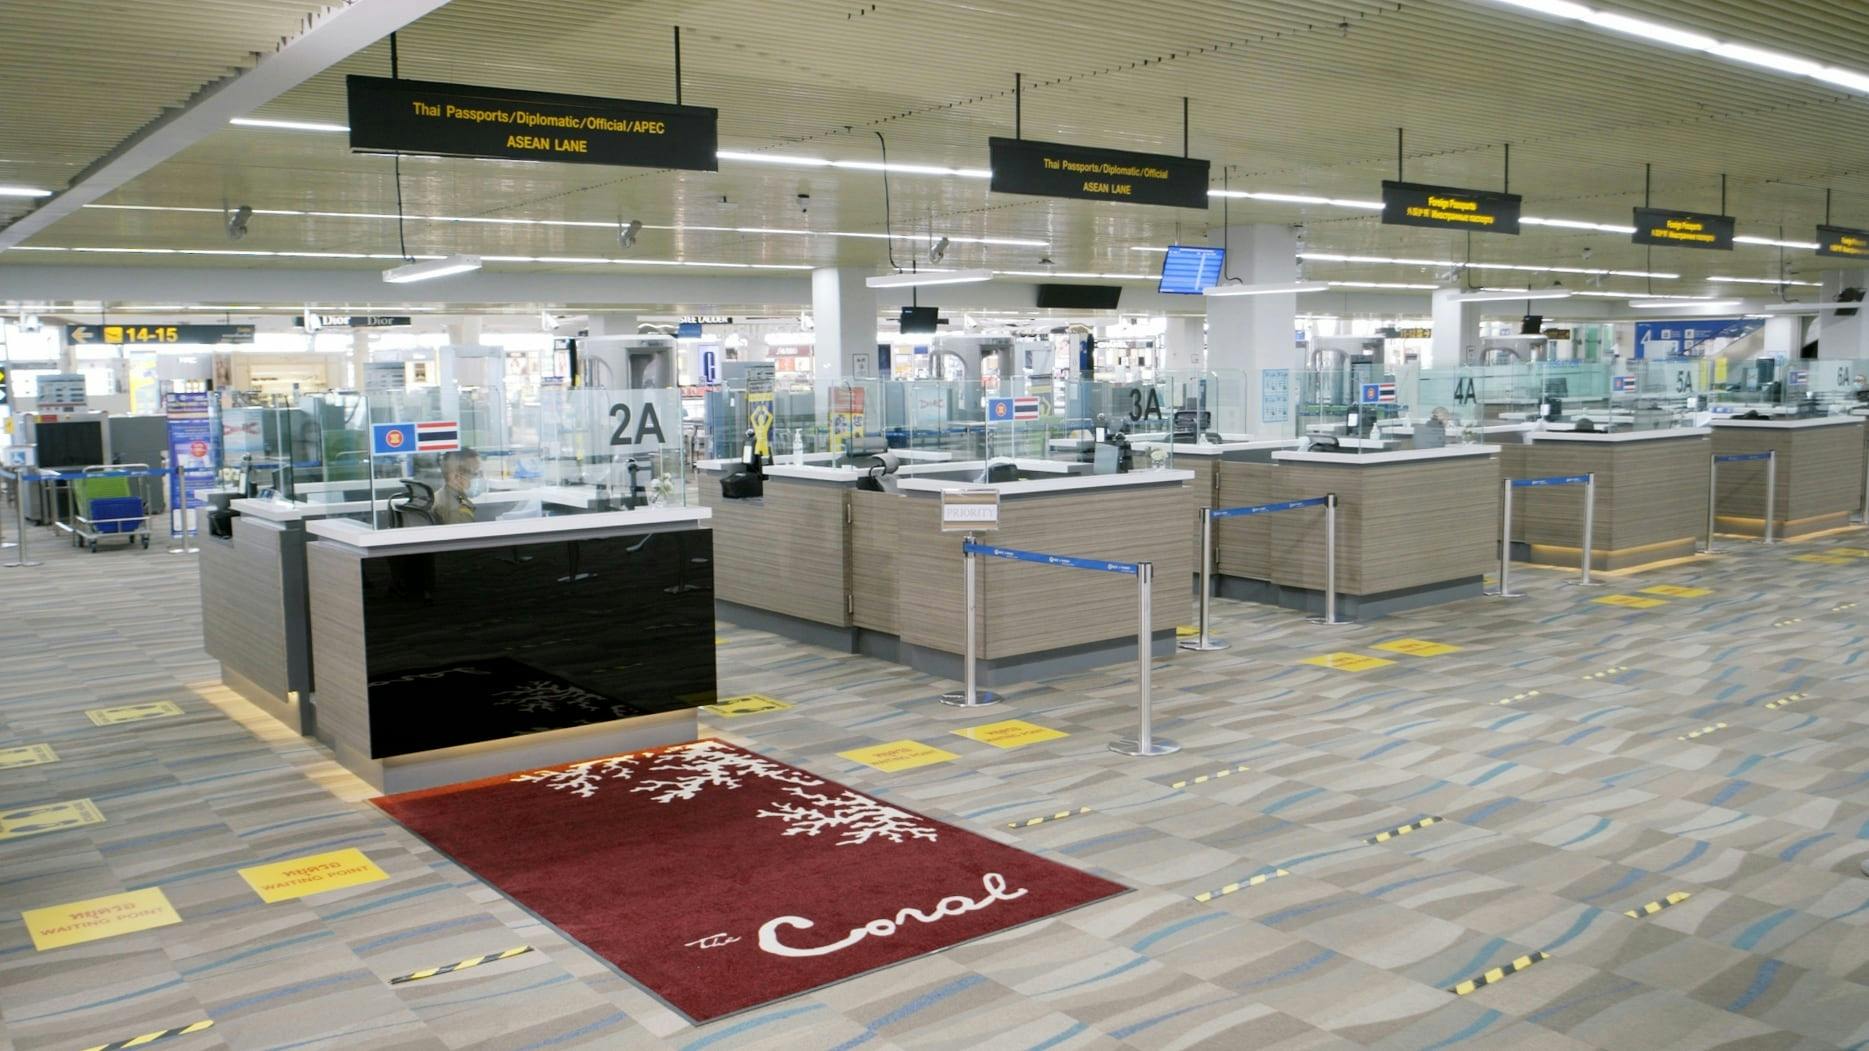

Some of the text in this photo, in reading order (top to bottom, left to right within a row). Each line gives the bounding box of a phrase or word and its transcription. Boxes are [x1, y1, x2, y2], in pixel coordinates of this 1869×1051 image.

[412, 101, 665, 135] Thai Passports/Diplomatic/Official/APEC
[506, 134, 588, 153] ASEAN LANE
[1043, 158, 1169, 179] Thai Passports/Diplomatic/Official
[1083, 181, 1132, 195] ASEAN LANE
[368, 316, 394, 326] Dior
[126, 327, 178, 342] 14-15
[1454, 377, 1477, 404] 4A
[1676, 370, 1693, 393] 5A
[1129, 387, 1162, 422] 3A
[609, 402, 666, 446] 2A
[945, 507, 996, 519] PRIORITY
[261, 864, 370, 893] WAITING POINT
[39, 905, 165, 937] WAITING POINT
[757, 872, 1029, 958] Coral
